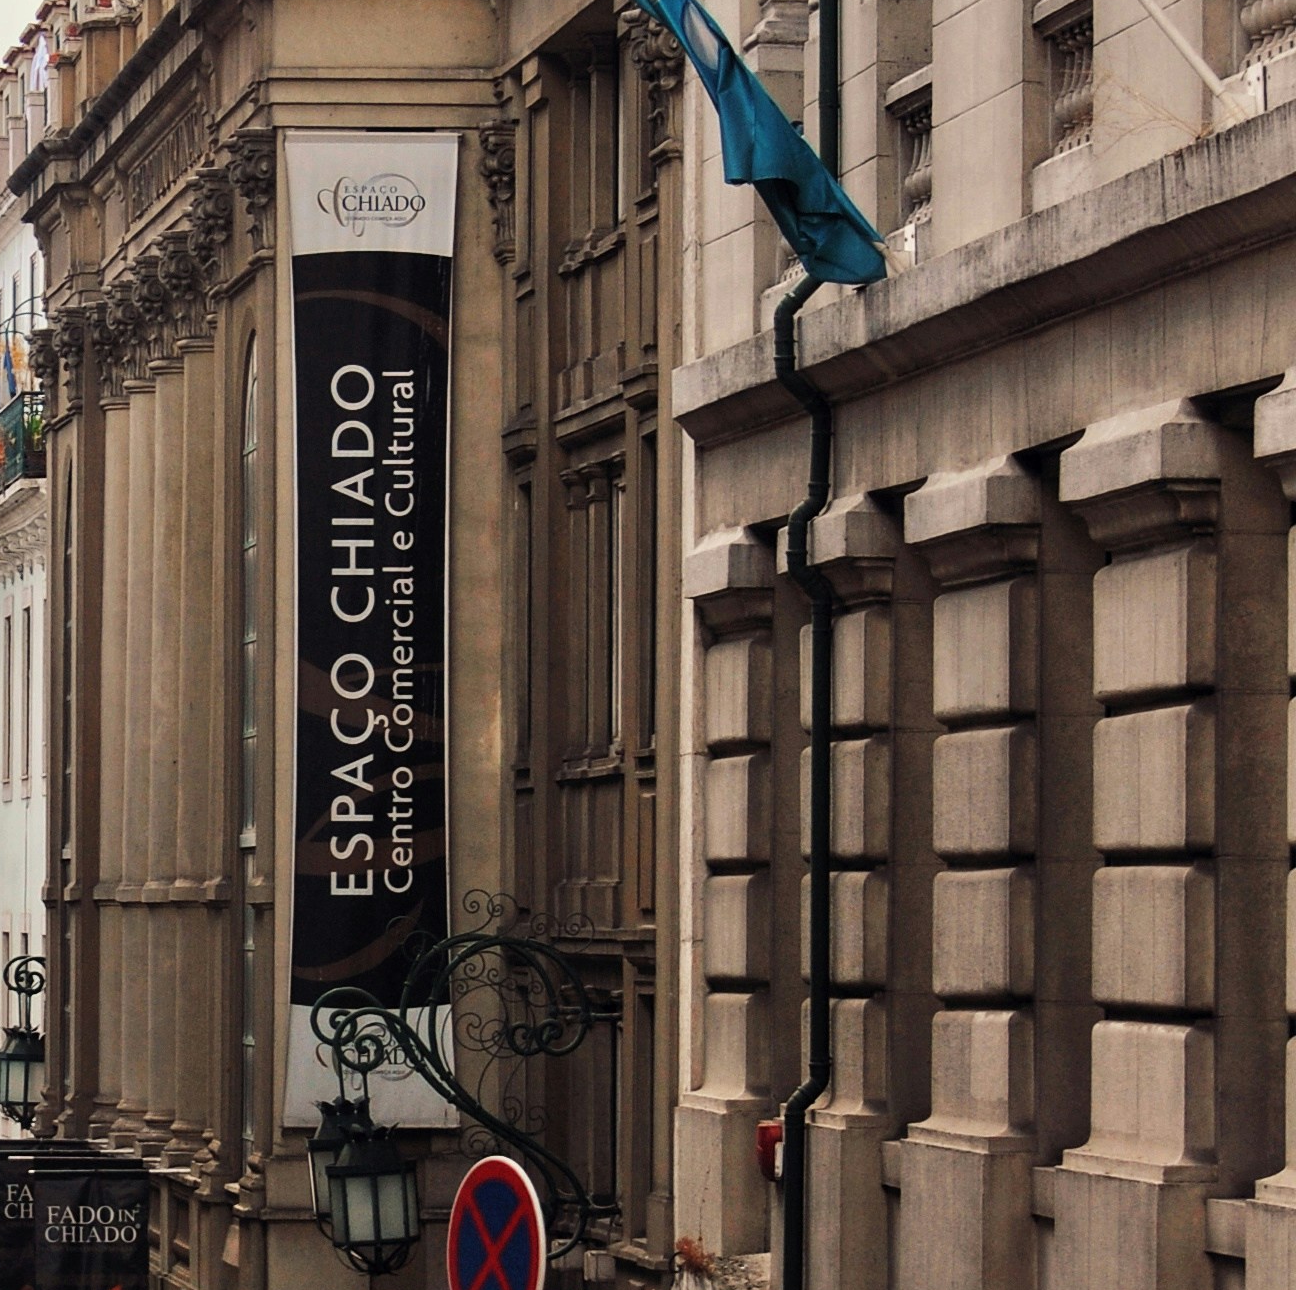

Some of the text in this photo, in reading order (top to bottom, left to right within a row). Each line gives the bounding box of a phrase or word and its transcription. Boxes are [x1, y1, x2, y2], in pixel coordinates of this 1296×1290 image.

[345, 185, 398, 195] ESPAÇO
[342, 195, 426, 211] CHIADO
[330, 364, 389, 896] ESPAÇO CHIADO
[382, 369, 414, 893] Centro Comercial e Cultural
[7, 1184, 33, 1201] FA
[47, 1205, 114, 1224] FADO
[118, 1210, 135, 1222] IN
[45, 1226, 137, 1243] CHIADO
